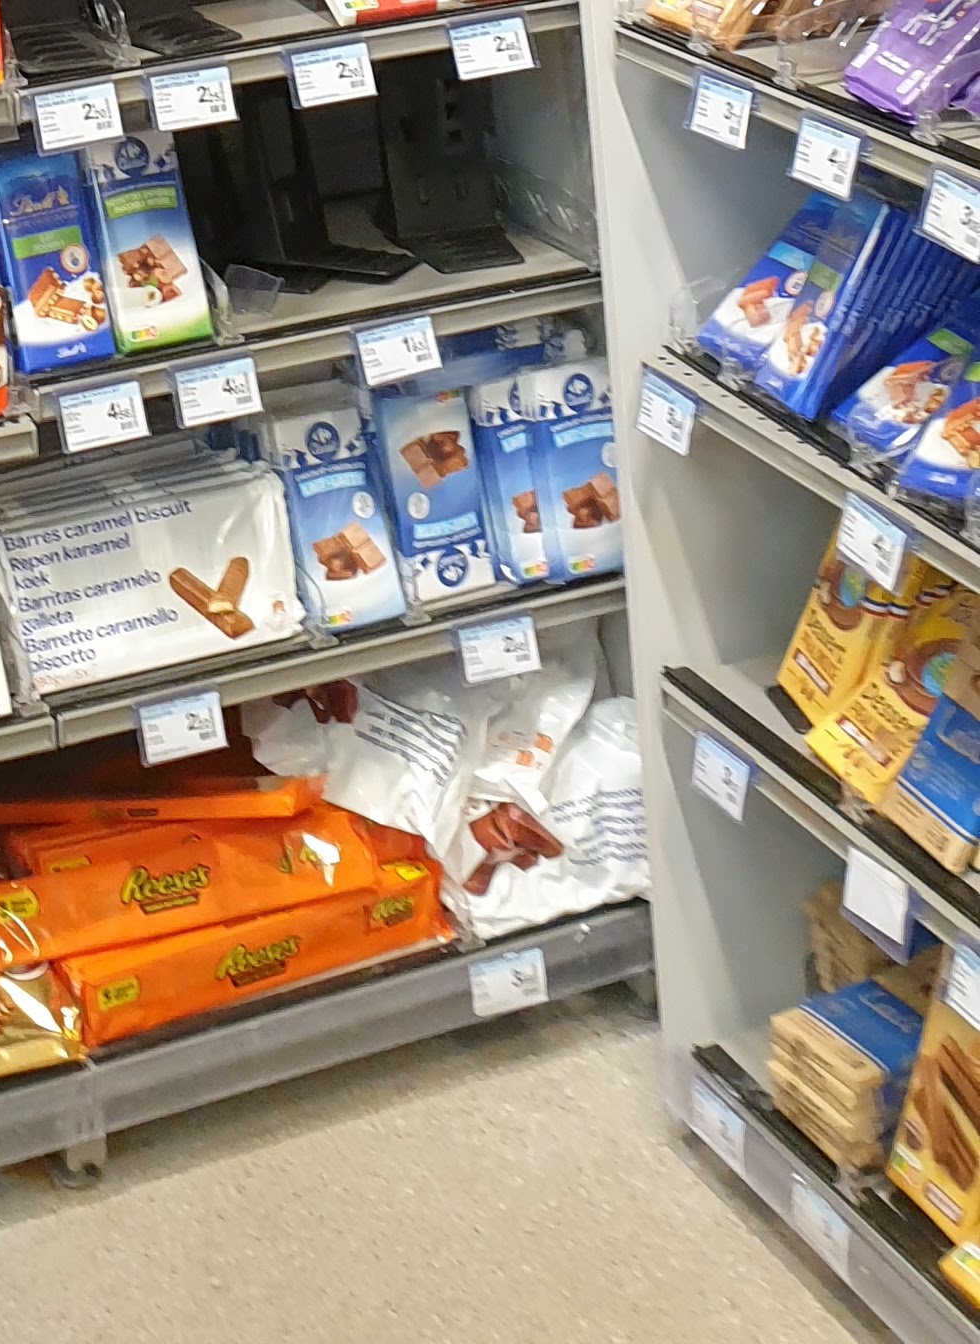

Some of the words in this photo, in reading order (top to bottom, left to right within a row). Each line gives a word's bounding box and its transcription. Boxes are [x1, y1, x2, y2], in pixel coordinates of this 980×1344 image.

[2, 525, 62, 554] Barres
[64, 512, 133, 542] caramel
[134, 498, 193, 525] biscuit
[62, 532, 131, 562] karamel
[18, 584, 83, 614] Barritas
[84, 568, 162, 601] caramelo
[96, 606, 179, 642] caramello
